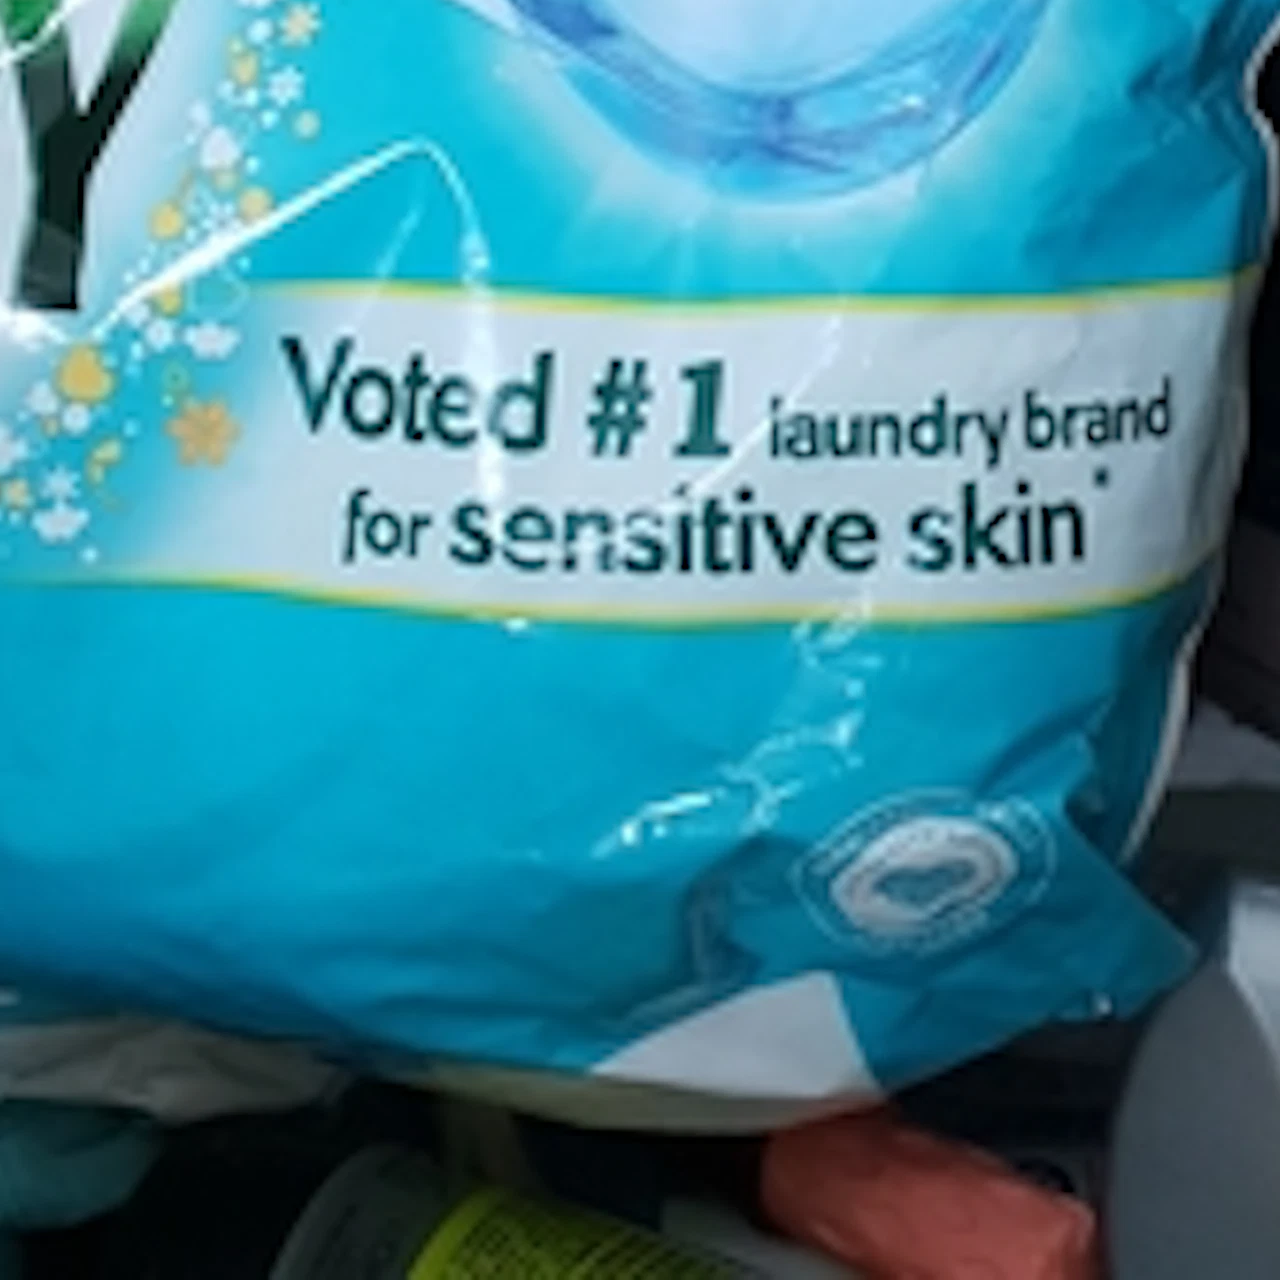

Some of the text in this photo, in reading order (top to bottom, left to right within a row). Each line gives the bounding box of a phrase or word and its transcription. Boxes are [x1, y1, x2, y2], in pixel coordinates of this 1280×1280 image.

[280, 334, 556, 453] Voted
[1022, 378, 1174, 451] brand
[342, 490, 433, 565] for
[447, 483, 880, 576] sensitive
